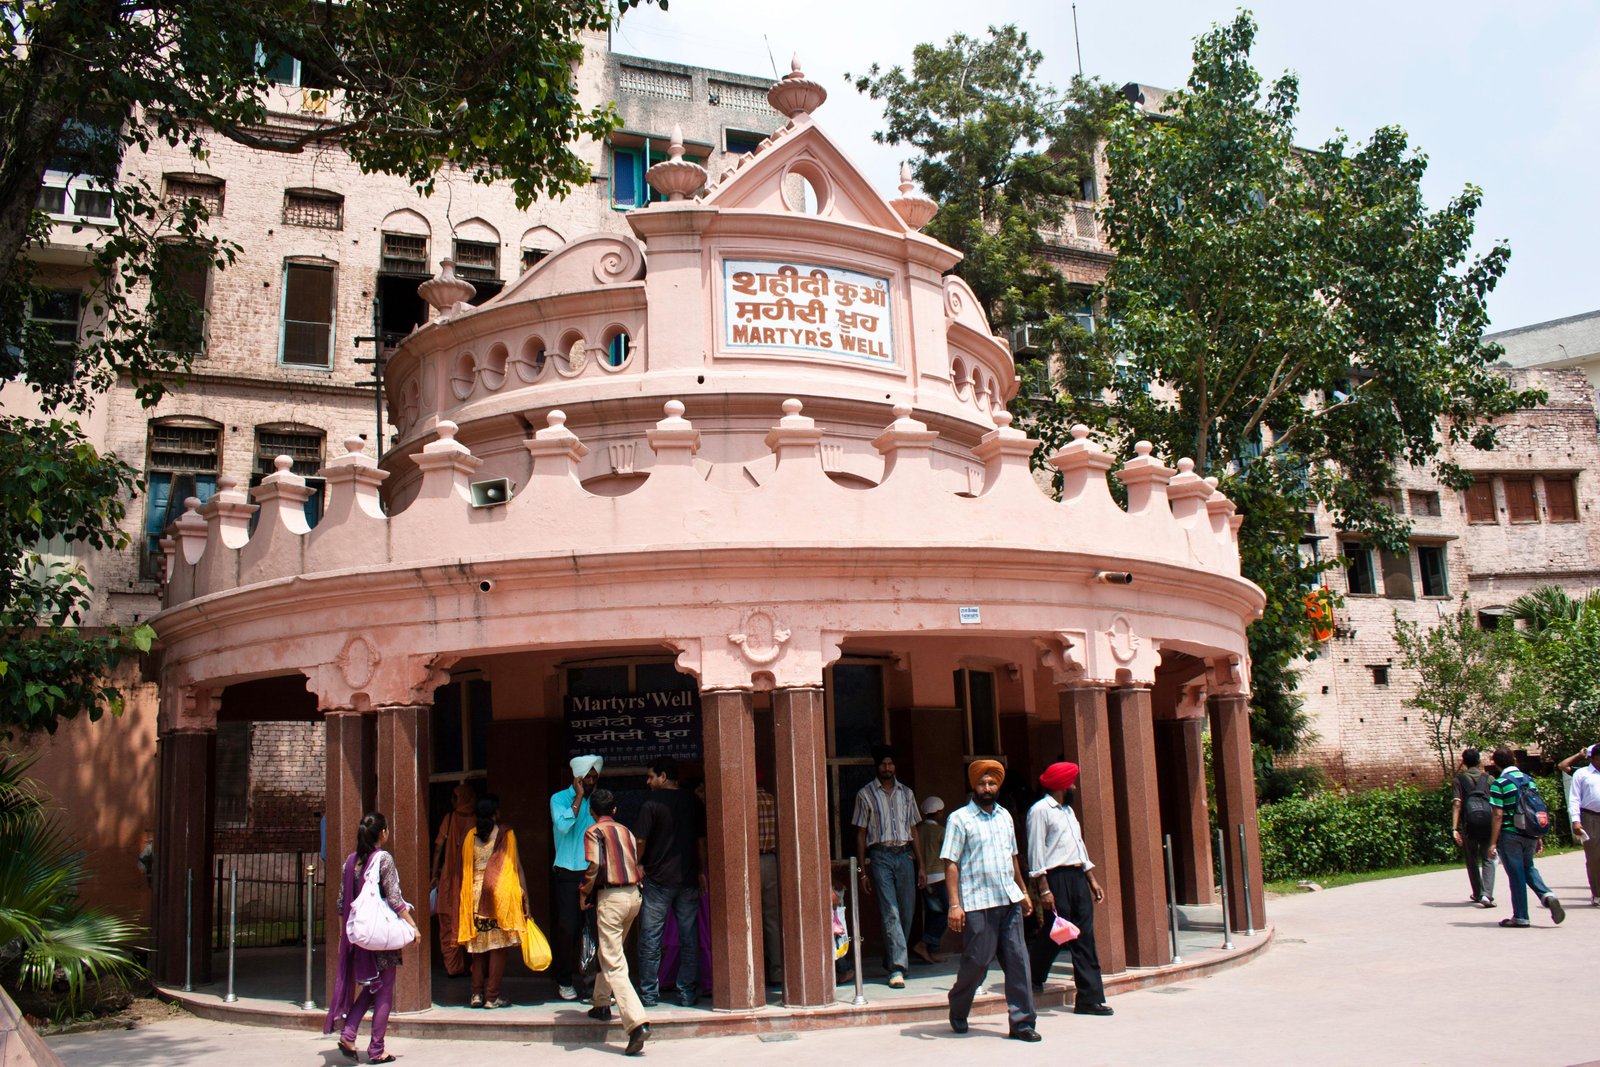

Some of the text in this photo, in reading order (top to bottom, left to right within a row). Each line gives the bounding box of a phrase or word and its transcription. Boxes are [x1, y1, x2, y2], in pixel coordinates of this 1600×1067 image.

[732, 265, 887, 308] शहीदी कुआँ
[735, 298, 880, 334] ਸ਼ਹੀਦੀ ਖੂਹ
[732, 324, 889, 358] MARTYR'S WELL
